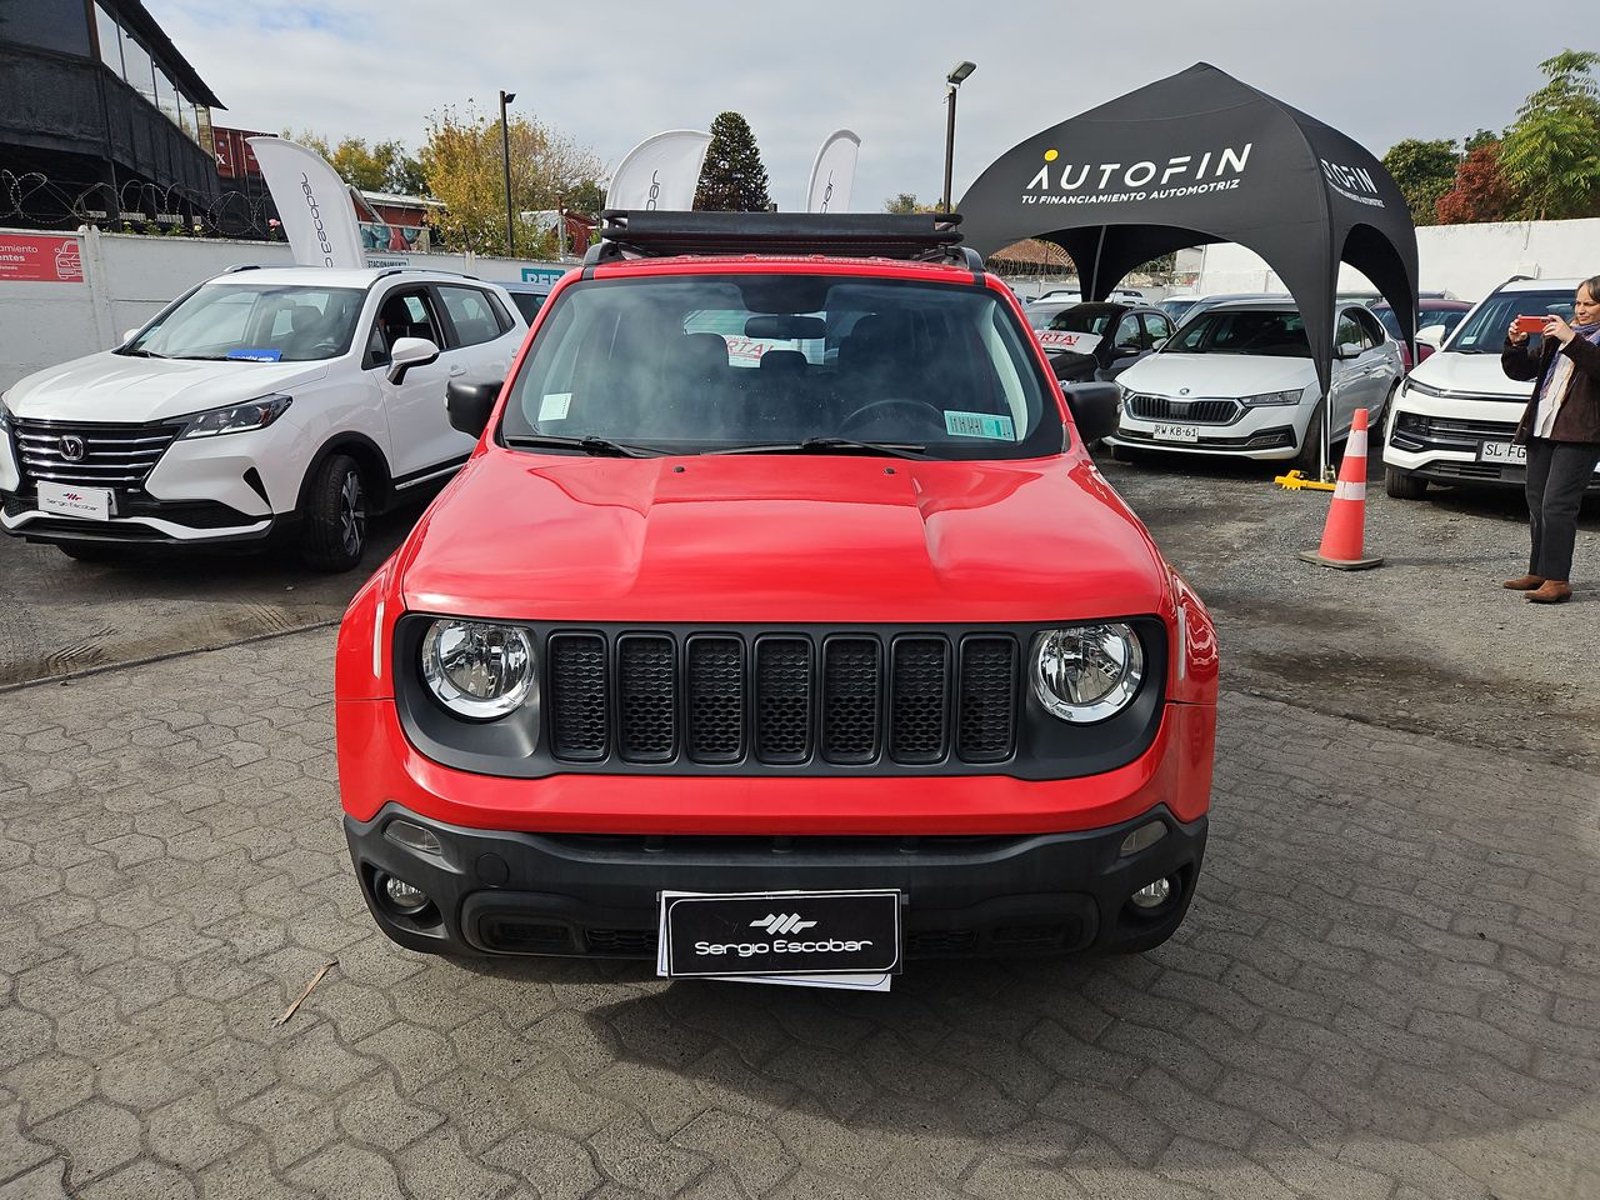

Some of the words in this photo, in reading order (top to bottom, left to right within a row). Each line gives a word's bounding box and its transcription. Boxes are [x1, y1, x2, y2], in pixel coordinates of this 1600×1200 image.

[1026, 143, 1252, 190] AUTOFIN
[1021, 195, 1036, 204] TU
[1039, 191, 1147, 205] FINANCIAMIENTO
[1149, 178, 1241, 200] AUTOMOTRIZ
[694, 941, 770, 957] Sergio
[772, 938, 873, 954] Escobar
